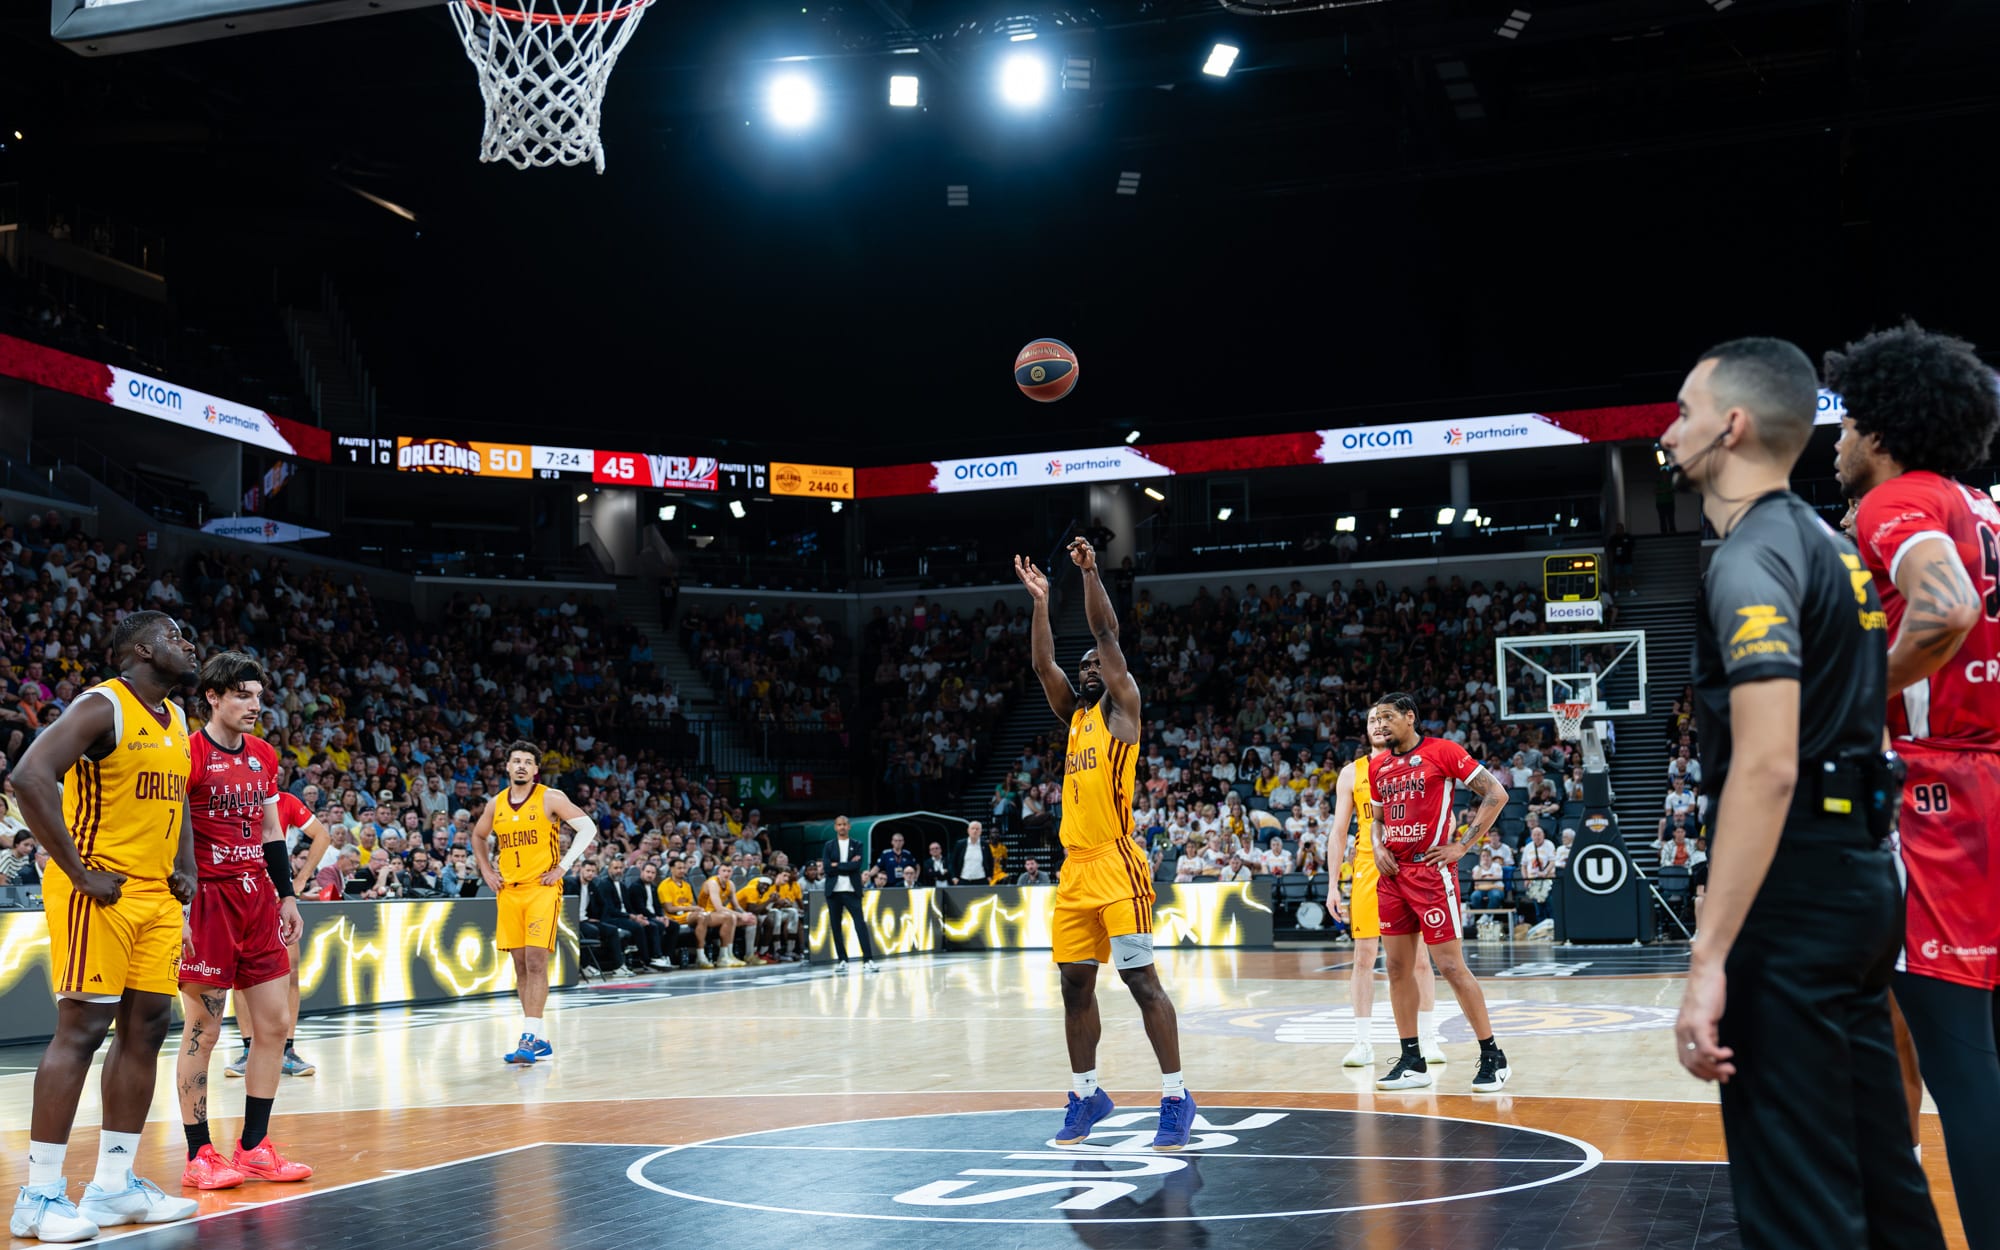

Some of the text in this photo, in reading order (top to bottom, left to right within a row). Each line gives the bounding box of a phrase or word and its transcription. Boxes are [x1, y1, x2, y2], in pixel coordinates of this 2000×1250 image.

[128, 379, 182, 410] orcom
[218, 412, 260, 432] partnaire
[338, 436, 370, 447] FAUTES
[1342, 429, 1413, 449] orcom
[1466, 424, 1528, 443] partnaire
[378, 439, 392, 448] TM
[350, 449, 357, 462] 1
[380, 451, 390, 464] 0
[399, 443, 480, 473] ORLÉANS
[489, 448, 523, 472] 50
[546, 451, 581, 466] 7:24
[1065, 456, 1121, 474] partnaire
[602, 457, 635, 479] 45
[719, 463, 746, 473] FAUTES
[753, 464, 766, 474] TM
[954, 461, 1018, 480] orcom
[729, 474, 736, 487] 1
[755, 476, 765, 488] 0
[809, 481, 849, 494] 2440 €
[1550, 605, 1595, 617] koesio
[135, 770, 187, 803] ORLÉAN
[1378, 778, 1425, 797] HALLANS
[209, 790, 266, 810] CHALLAN
[1913, 783, 1949, 815] 98
[1391, 804, 1406, 821] 00
[164, 808, 175, 840] 7
[241, 820, 252, 839] 6
[514, 850, 521, 868] 1
[1586, 857, 1614, 884] U
